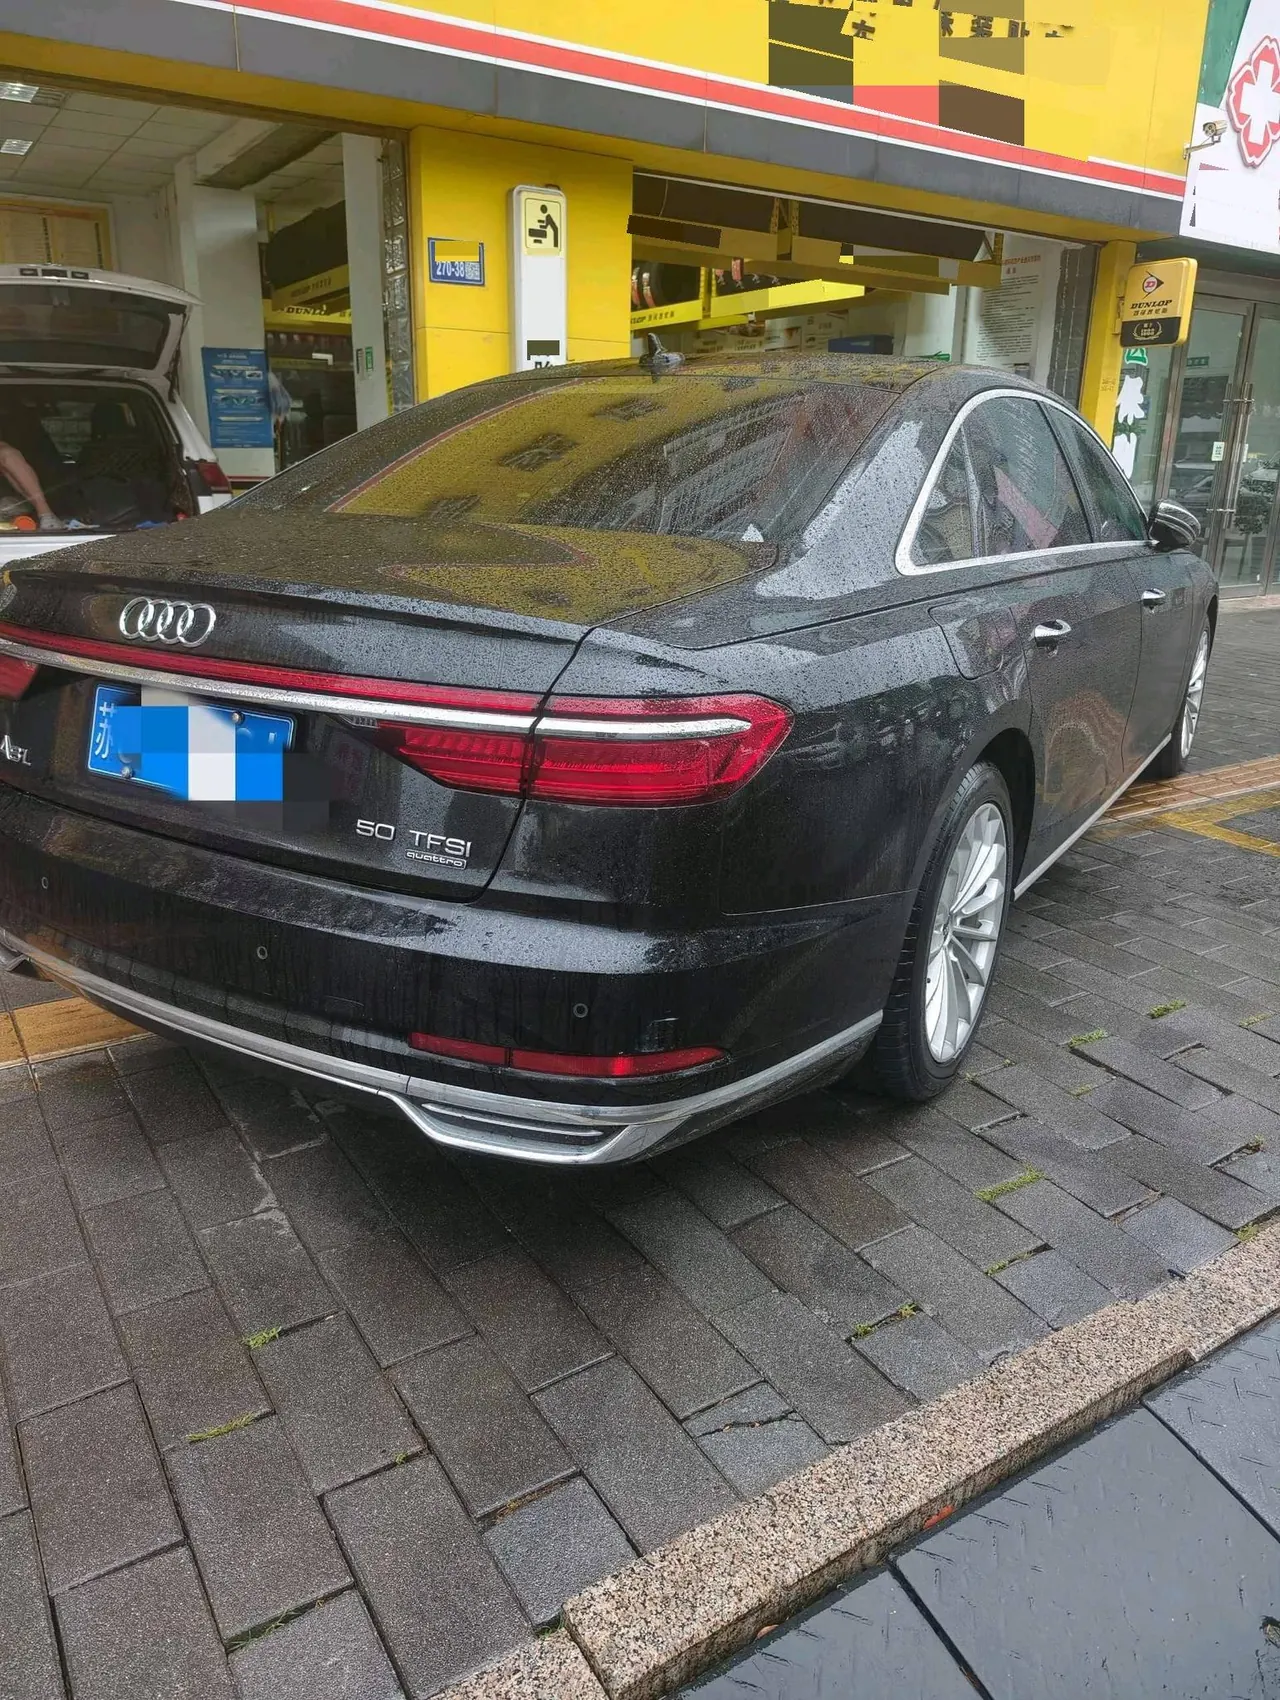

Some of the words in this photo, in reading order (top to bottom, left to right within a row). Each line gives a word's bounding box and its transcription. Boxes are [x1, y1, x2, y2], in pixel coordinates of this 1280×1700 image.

[1130, 300, 1173, 310] DUNLOP
[356, 819, 395, 841] 50
[409, 830, 472, 857] TFSI
[406, 851, 463, 867] quattro
